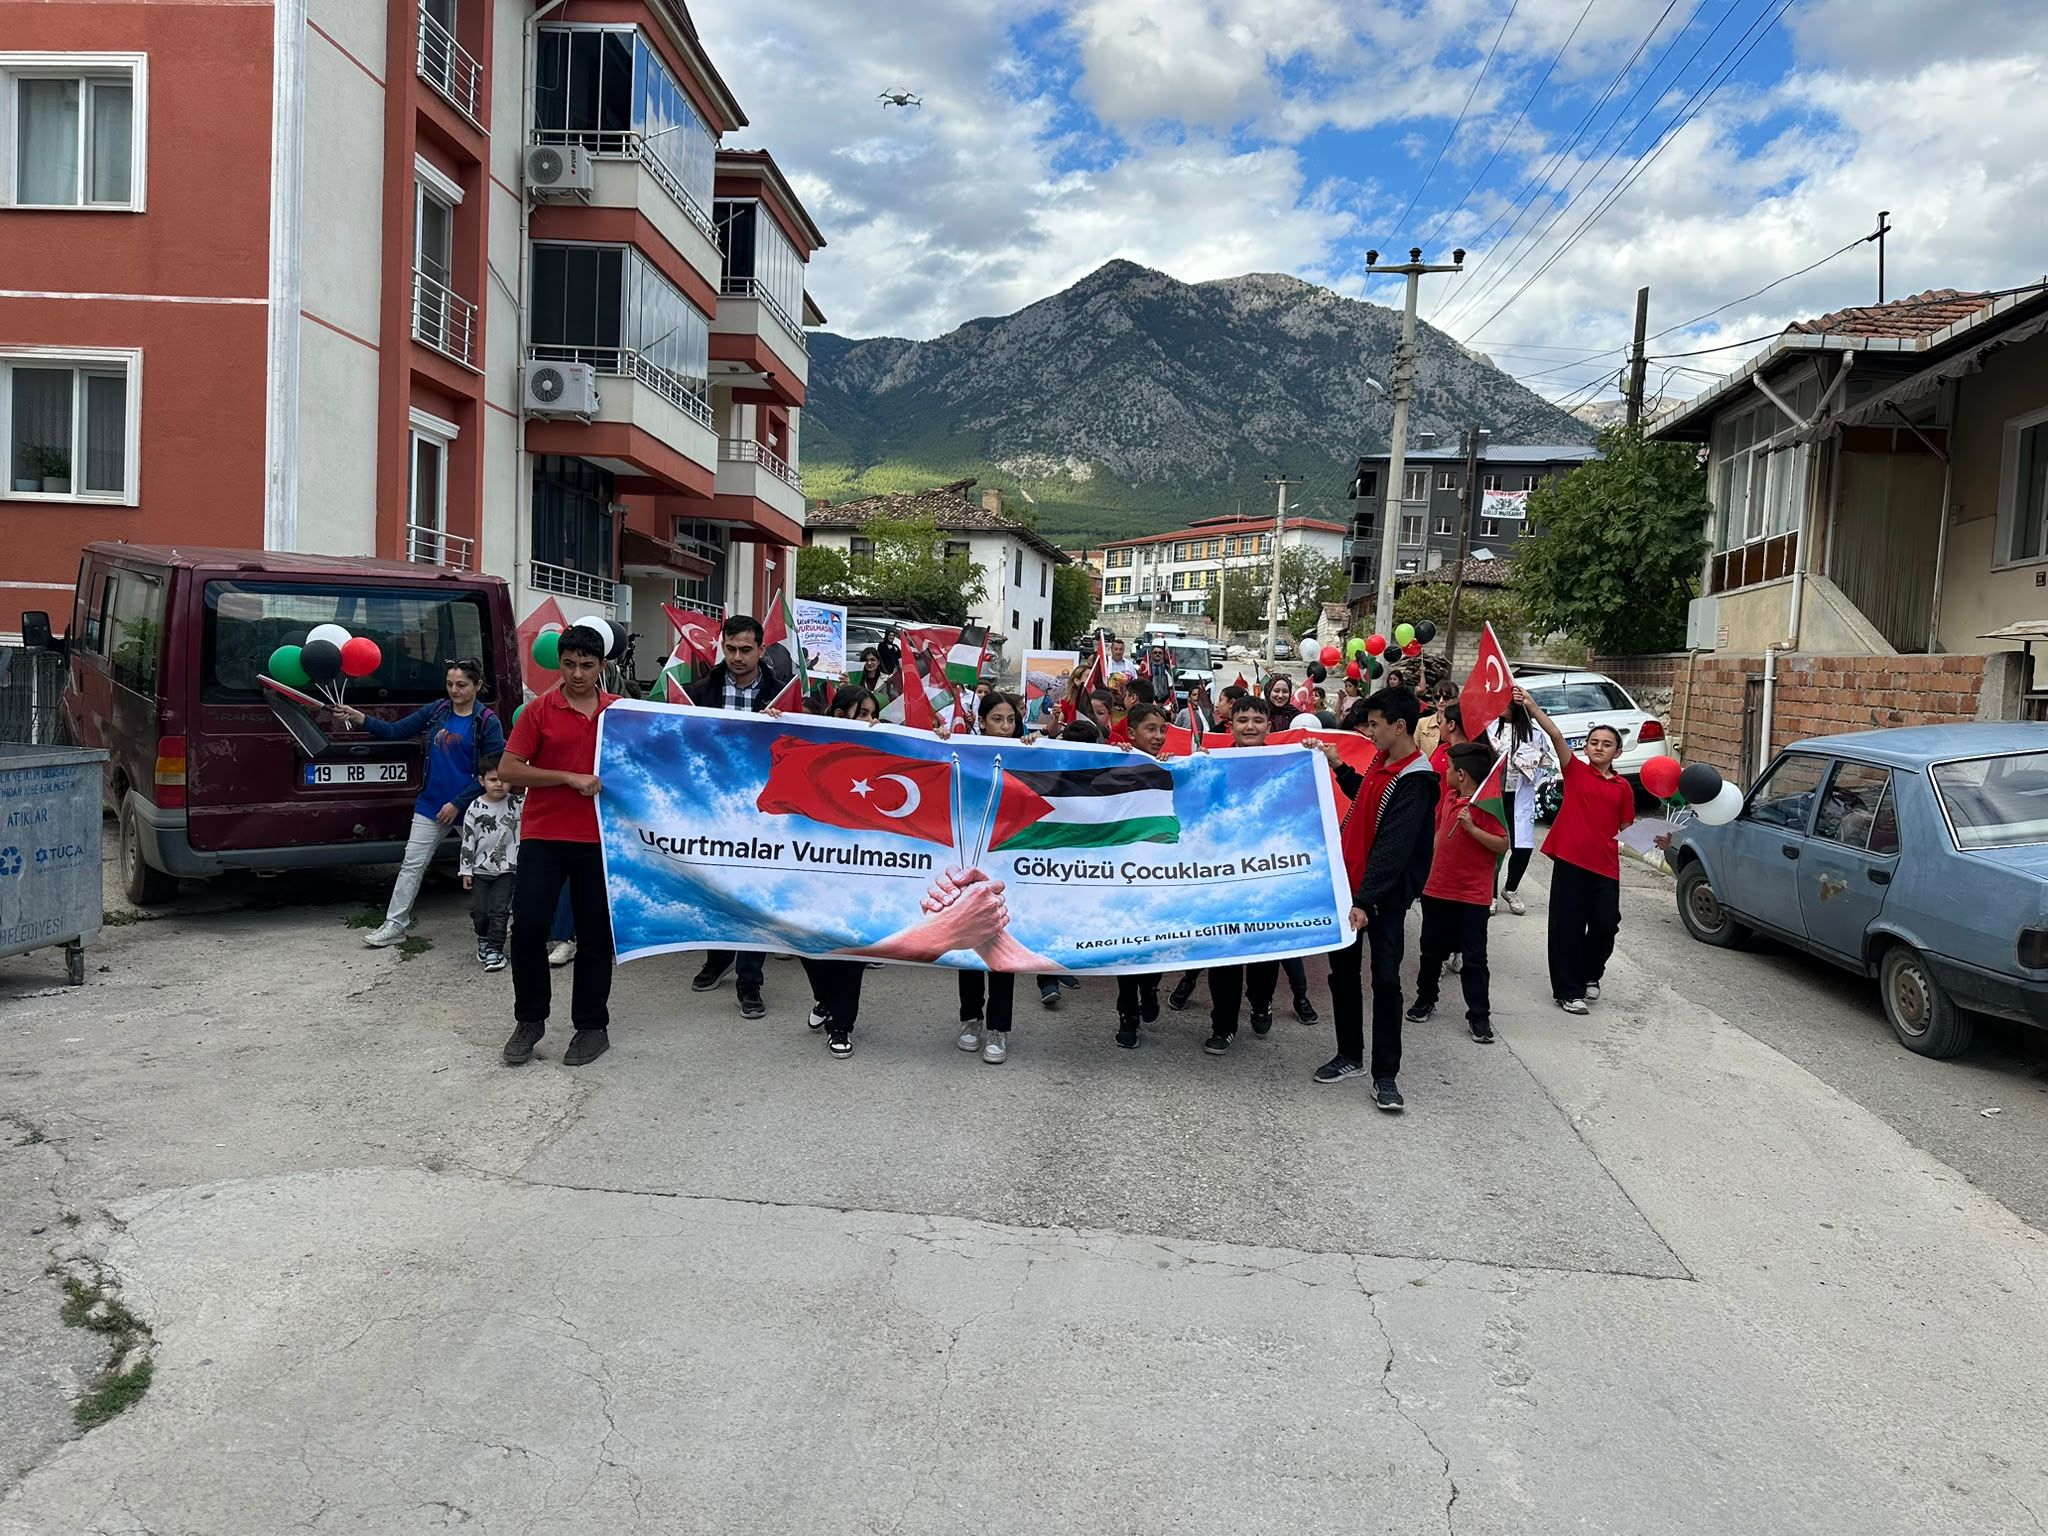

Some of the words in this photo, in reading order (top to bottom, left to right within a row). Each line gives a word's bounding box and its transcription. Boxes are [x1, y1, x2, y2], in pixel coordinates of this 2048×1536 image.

[315, 766, 331, 782] 19
[347, 766, 365, 781] RB
[380, 765, 406, 781] 202
[638, 828, 785, 860] Uçurtmalar
[792, 840, 932, 870] Vurulmasın
[1013, 856, 1114, 883] Gökyüzü
[1121, 860, 1235, 884] Çocuklara
[1241, 852, 1311, 875] Kalsın
[1076, 938, 1117, 949] KARGI
[1122, 935, 1151, 945] İLÇE
